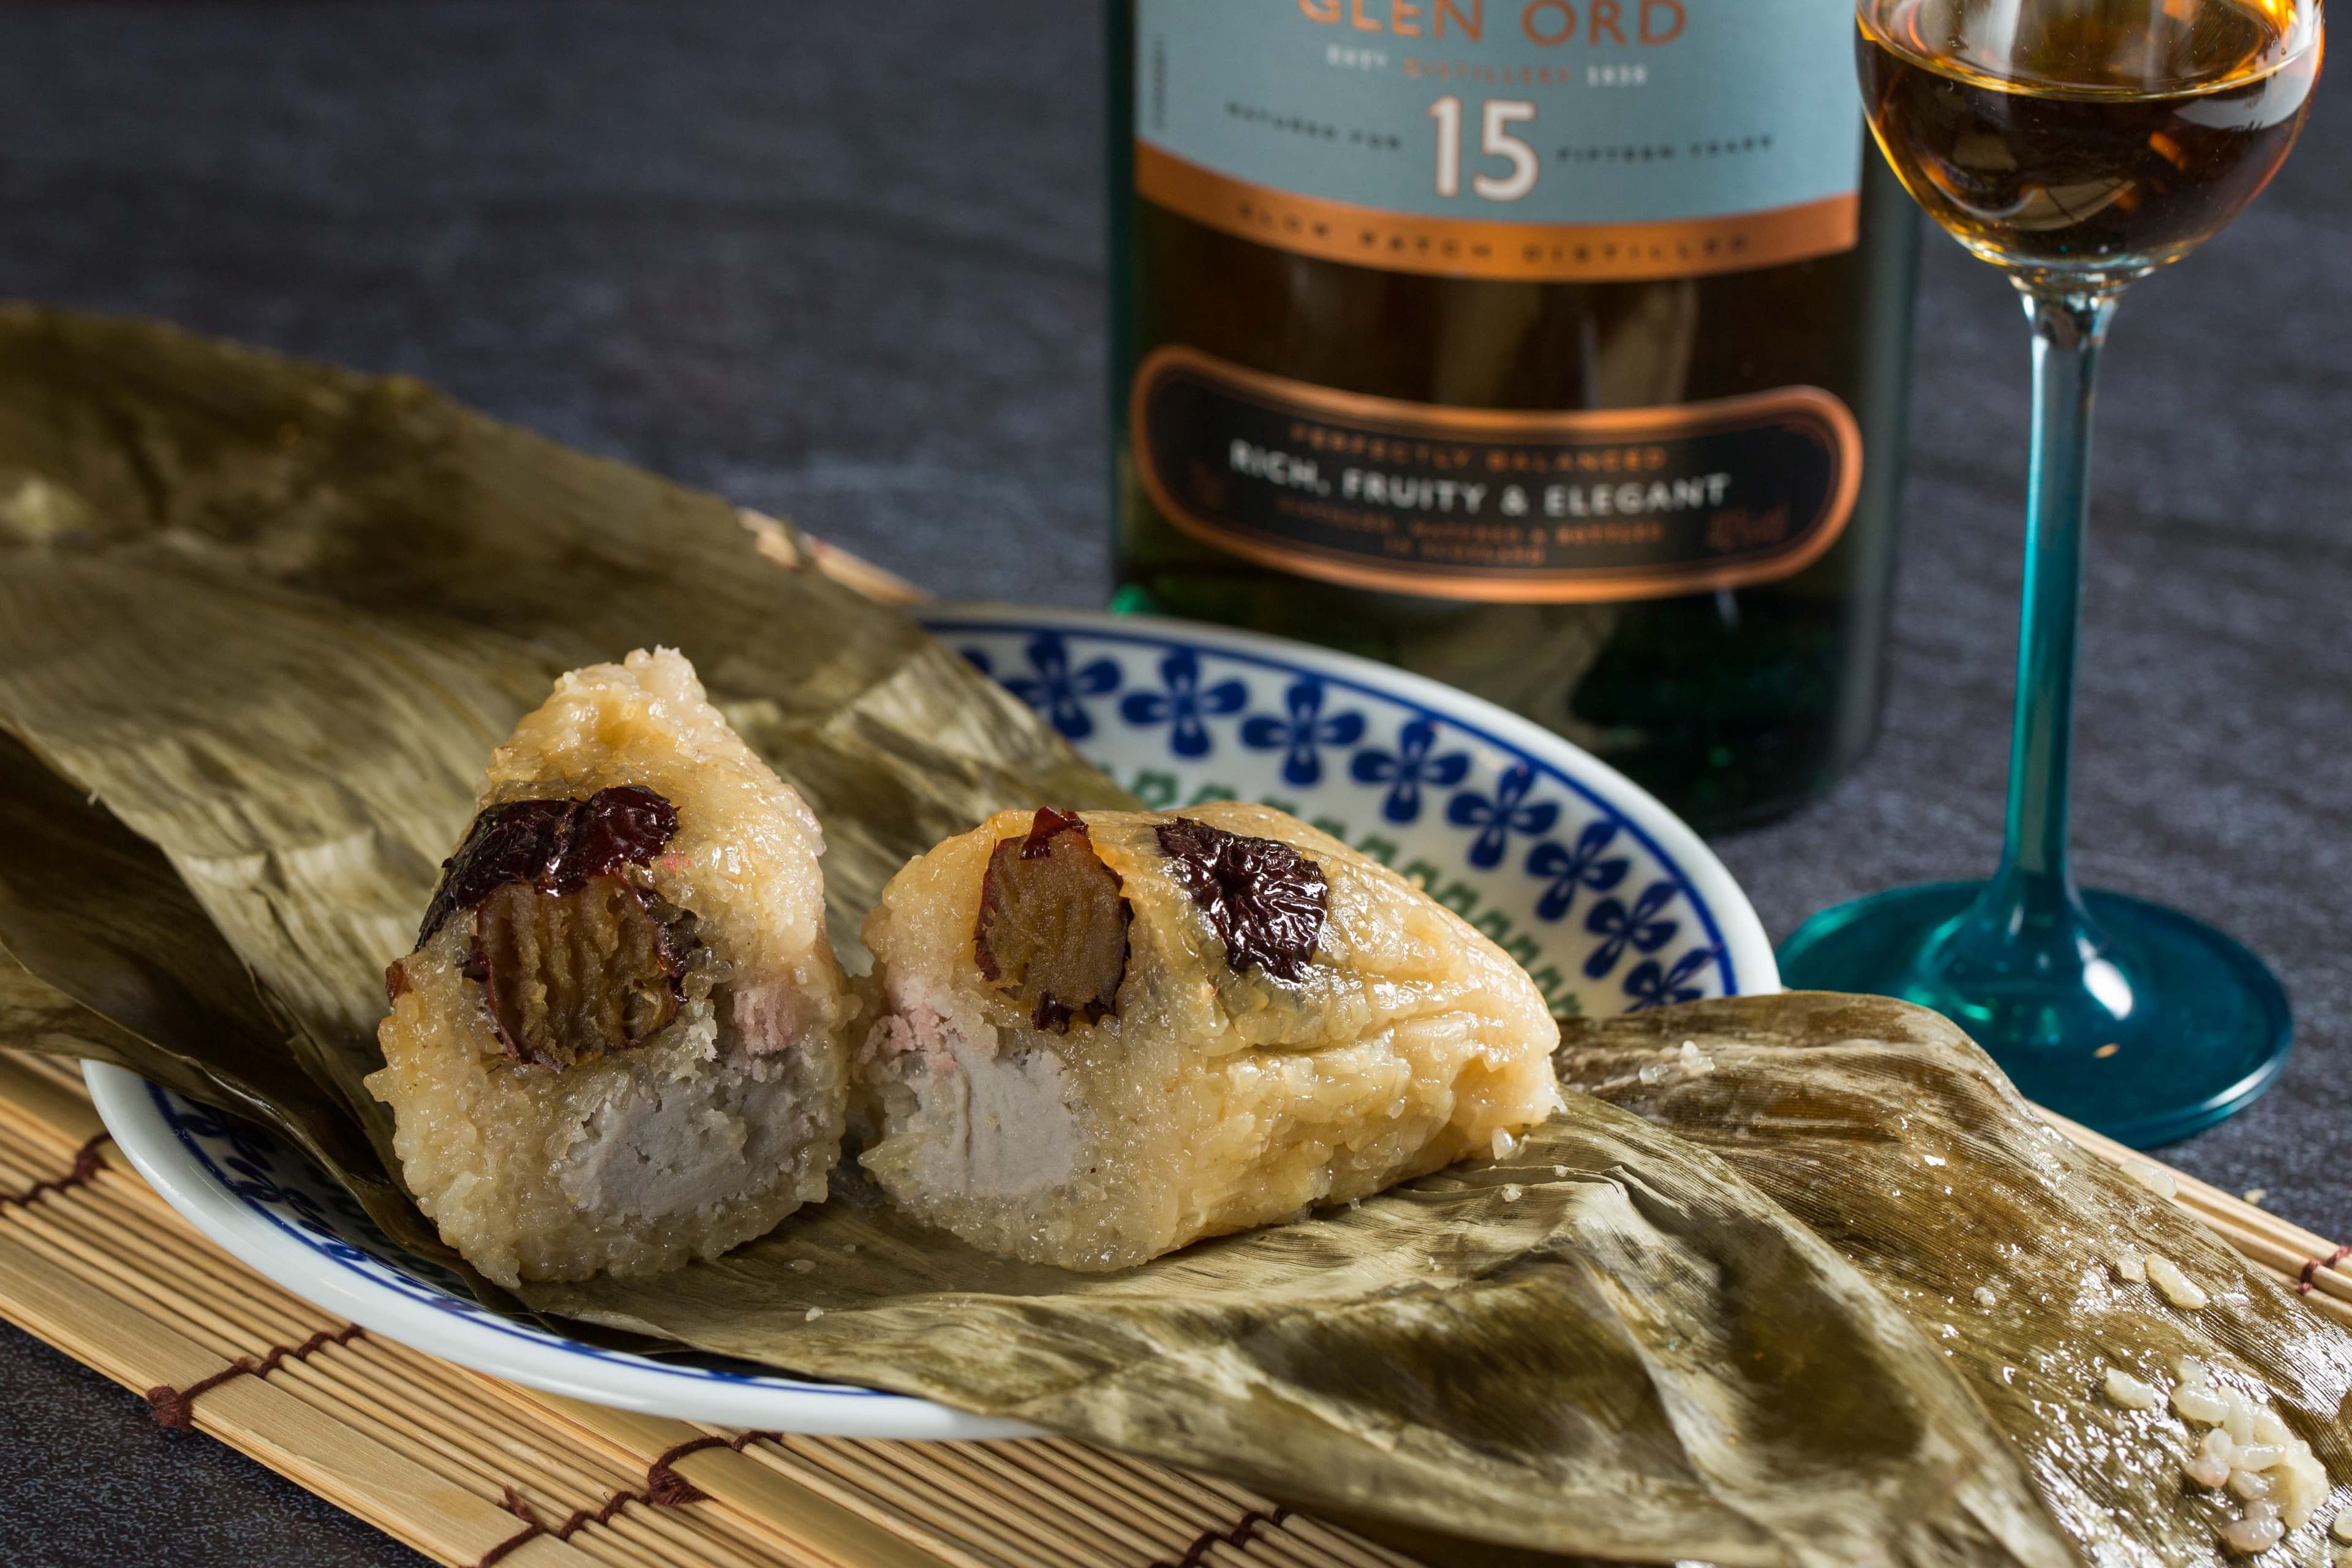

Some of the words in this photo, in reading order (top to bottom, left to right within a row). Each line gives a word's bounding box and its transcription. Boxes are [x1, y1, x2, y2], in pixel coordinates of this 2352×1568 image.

[1520, 0, 1687, 47] ORD
[1427, 96, 1539, 201] 15
[1229, 439, 1331, 497] RICH,
[1342, 467, 1487, 514] FRUITY
[1499, 484, 1528, 517] &
[1544, 472, 1732, 517] ELEGANT
[1290, 423, 1471, 470] PERFECTLY
[1485, 446, 1667, 473] BALANCED
